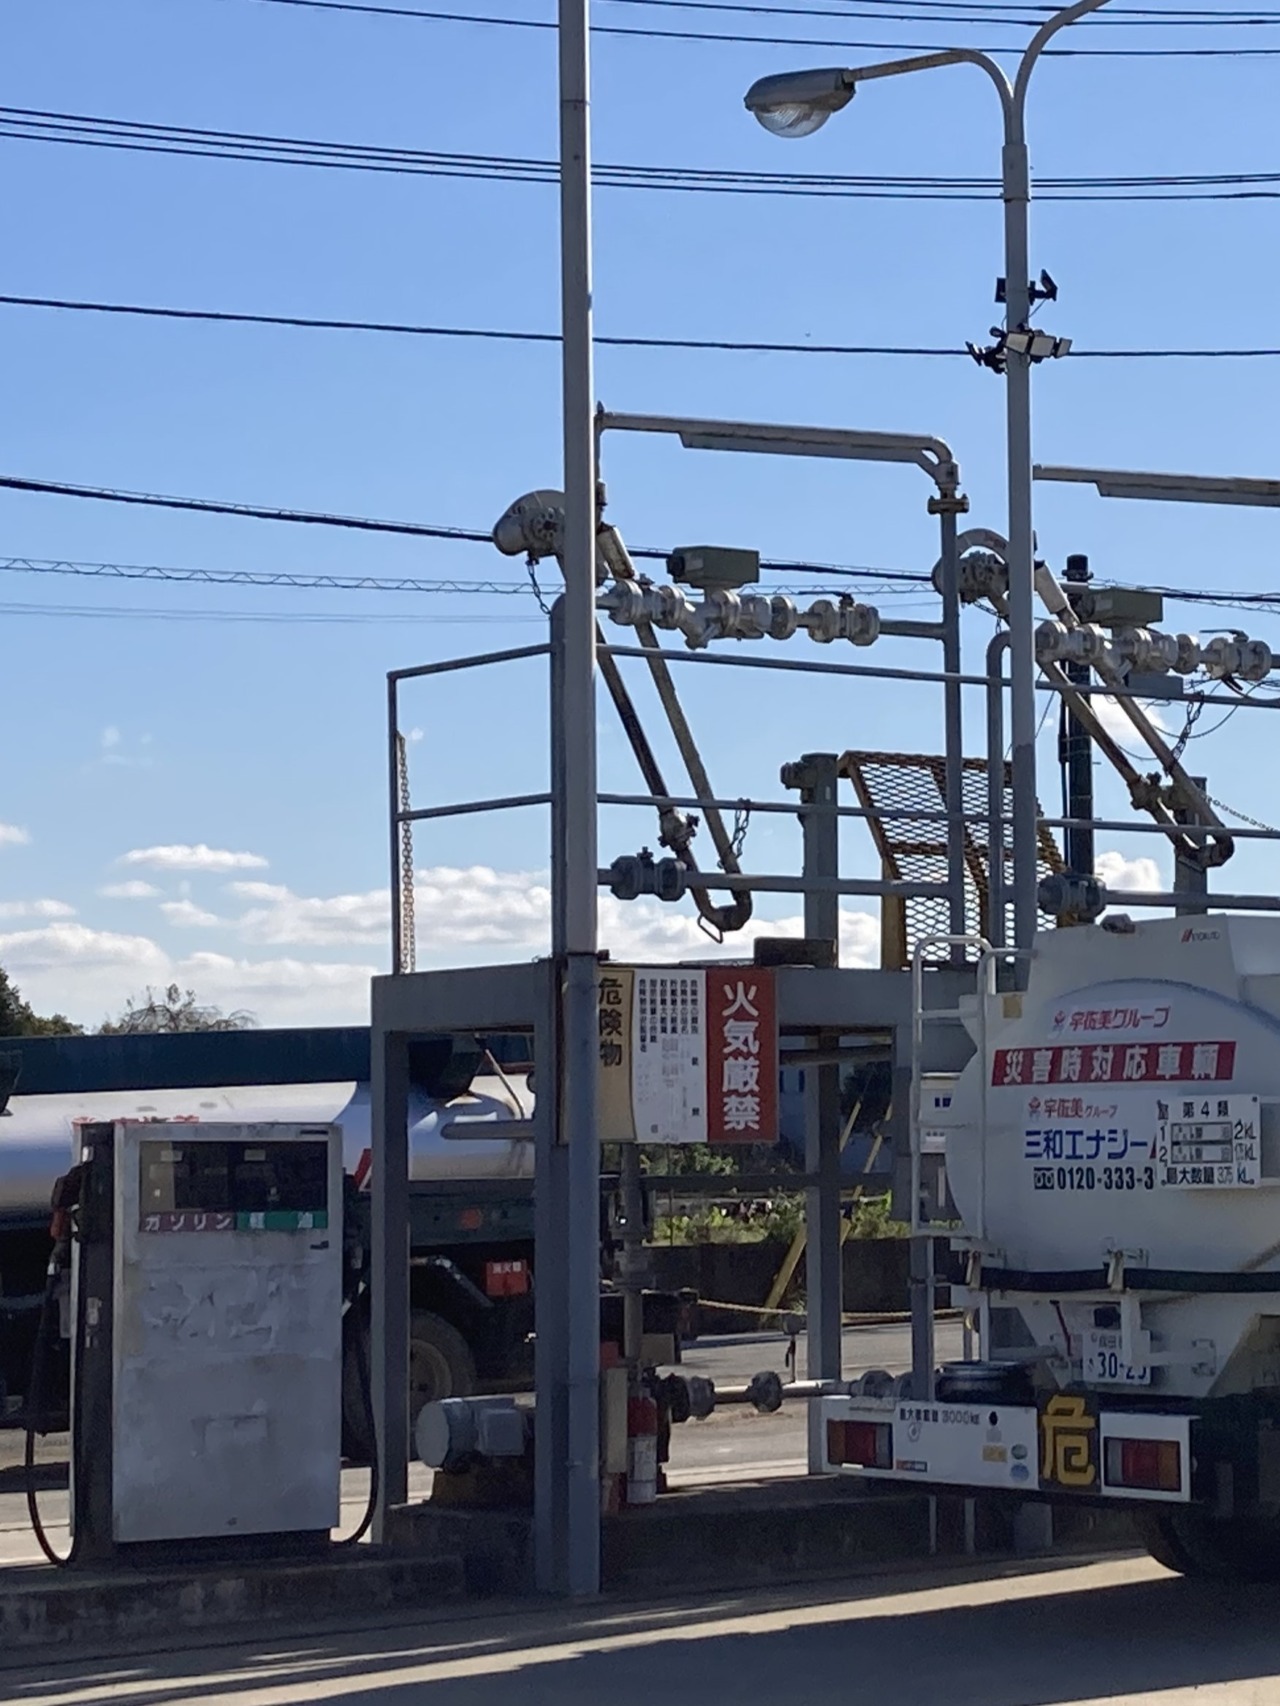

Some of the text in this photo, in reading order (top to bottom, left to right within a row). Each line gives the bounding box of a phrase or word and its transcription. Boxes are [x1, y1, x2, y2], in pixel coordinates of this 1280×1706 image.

[598, 976, 623, 1067] 危険物
[1068, 1005, 1172, 1031] 宇佐美グループ
[722, 980, 760, 1131] 火気厳禁
[1044, 1098, 1119, 1119] 宇佐美グループ
[1024, 1128, 1148, 1160] 三和エナジー
[145, 1212, 232, 1231] ガソリン
[1041, 1394, 1096, 1486] 危
